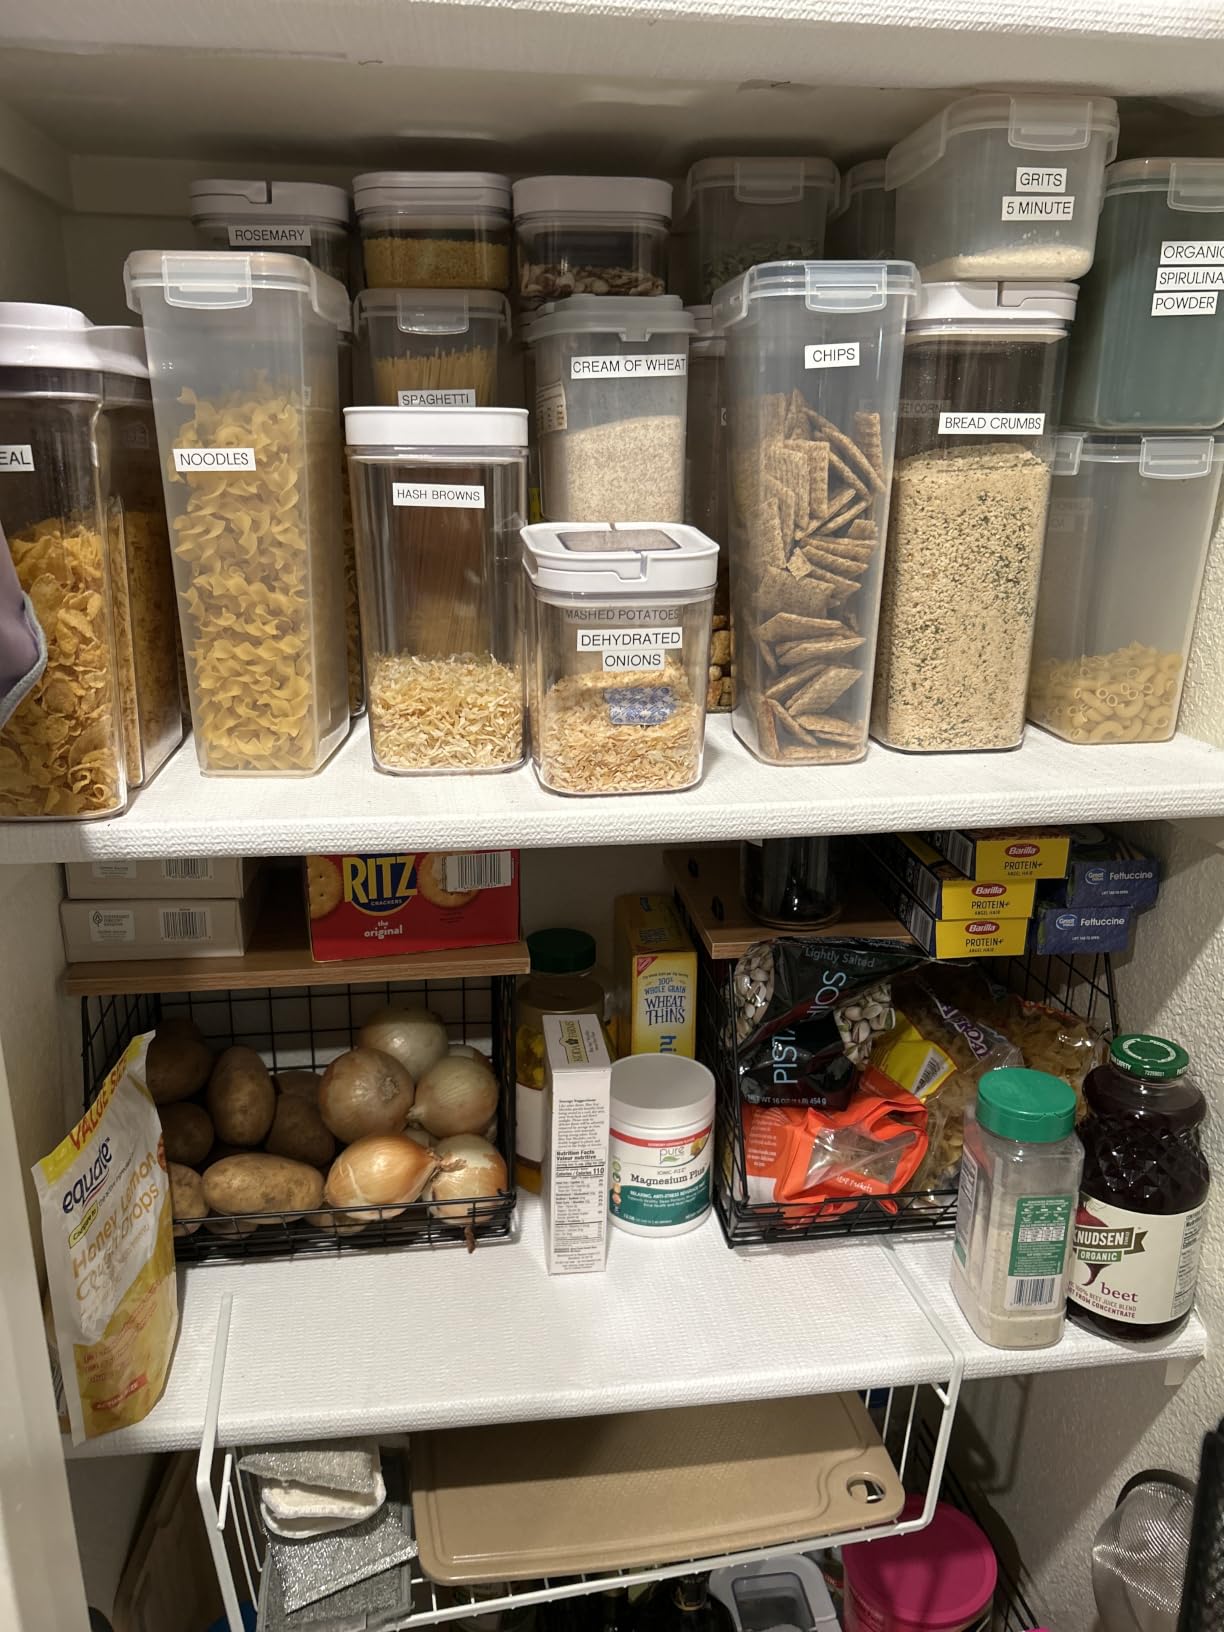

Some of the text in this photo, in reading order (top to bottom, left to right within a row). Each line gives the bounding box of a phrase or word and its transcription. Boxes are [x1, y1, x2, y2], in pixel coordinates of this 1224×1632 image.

[1020, 172, 1063, 187] GRITS
[1006, 201, 1072, 215] 5 MINUTE
[234, 229, 305, 241] ROSEMARY
[1159, 271, 1224, 285] SPIRULINA
[1155, 296, 1215, 310] POWDER
[812, 348, 855, 362] CHIPS
[572, 358, 686, 374] CREAM OF WHEAT
[402, 393, 469, 406] SPAGHETTI
[945, 417, 1042, 430] BREAD CRUMBS
[180, 452, 249, 466] NOODLES
[397, 489, 480, 502] HASH BROWNS
[566, 608, 680, 620] MASHED POTATOES
[581, 632, 681, 646] DEHYDRATED
[604, 654, 661, 667] ONIONS
[1007, 845, 1038, 856] Barilla
[1004, 861, 1043, 870] PROTEIN+
[342, 855, 417, 904] RITZ
[1109, 871, 1153, 881] Fettuccine
[974, 885, 1004, 896] Barilla
[971, 900, 1010, 910] PROTEIN+
[377, 919, 389, 927] the
[967, 923, 997, 934] Barilla
[1080, 917, 1126, 927] Fettuccine
[364, 925, 403, 940] original
[965, 938, 1004, 948] PROTEIN+
[804, 948, 876, 968] Lightly Salted
[644, 984, 687, 996] WHOLE GRAIN
[644, 995, 687, 1010] WHEAT
[810, 1097, 821, 1105] 454
[659, 1146, 685, 1165] pure
[593, 1167, 605, 1175] 110
[630, 1166, 706, 1187] Magnesium Plus
[62, 1142, 112, 1214] equate
[73, 1210, 118, 1279] Honey
[121, 1152, 157, 1210] Lemon
[121, 1182, 160, 1241] Drops
[1080, 1251, 1118, 1261] ORGANIC
[1100, 1282, 1139, 1303] beet
[1075, 1292, 1091, 1306] FROM
[1091, 1300, 1136, 1319] CONCENTRATE
[1118, 1302, 1137, 1312] BLEND
